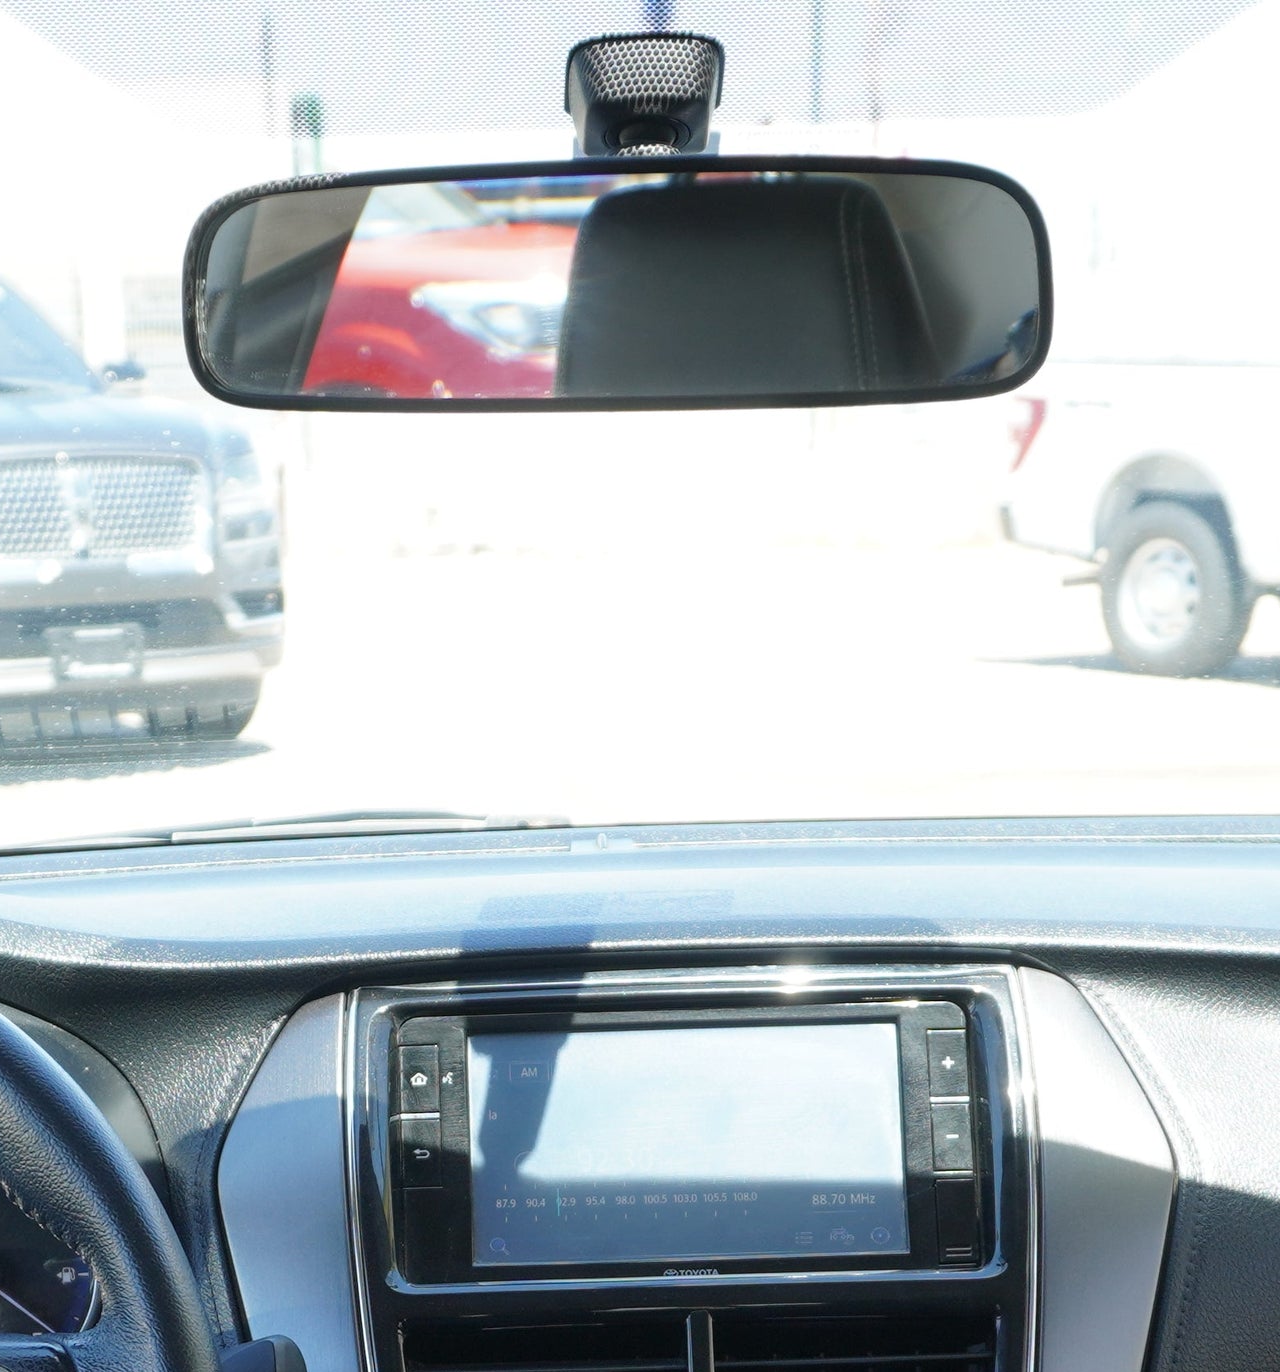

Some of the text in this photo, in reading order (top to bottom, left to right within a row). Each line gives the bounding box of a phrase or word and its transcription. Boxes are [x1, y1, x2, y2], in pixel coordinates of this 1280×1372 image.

[521, 1067, 538, 1077] AM
[495, 1198, 517, 1209] 87.9
[525, 1198, 546, 1208] 90.4
[585, 1196, 606, 1206] 95.4
[615, 1195, 636, 1206] 98.0
[643, 1194, 668, 1205] 100.5
[673, 1193, 698, 1204] 103.0
[703, 1192, 728, 1203] 105.5
[733, 1191, 758, 1202] 108.0
[811, 1193, 876, 1206] 88.70 MHz
[678, 1268, 720, 1277] TOYOTA
